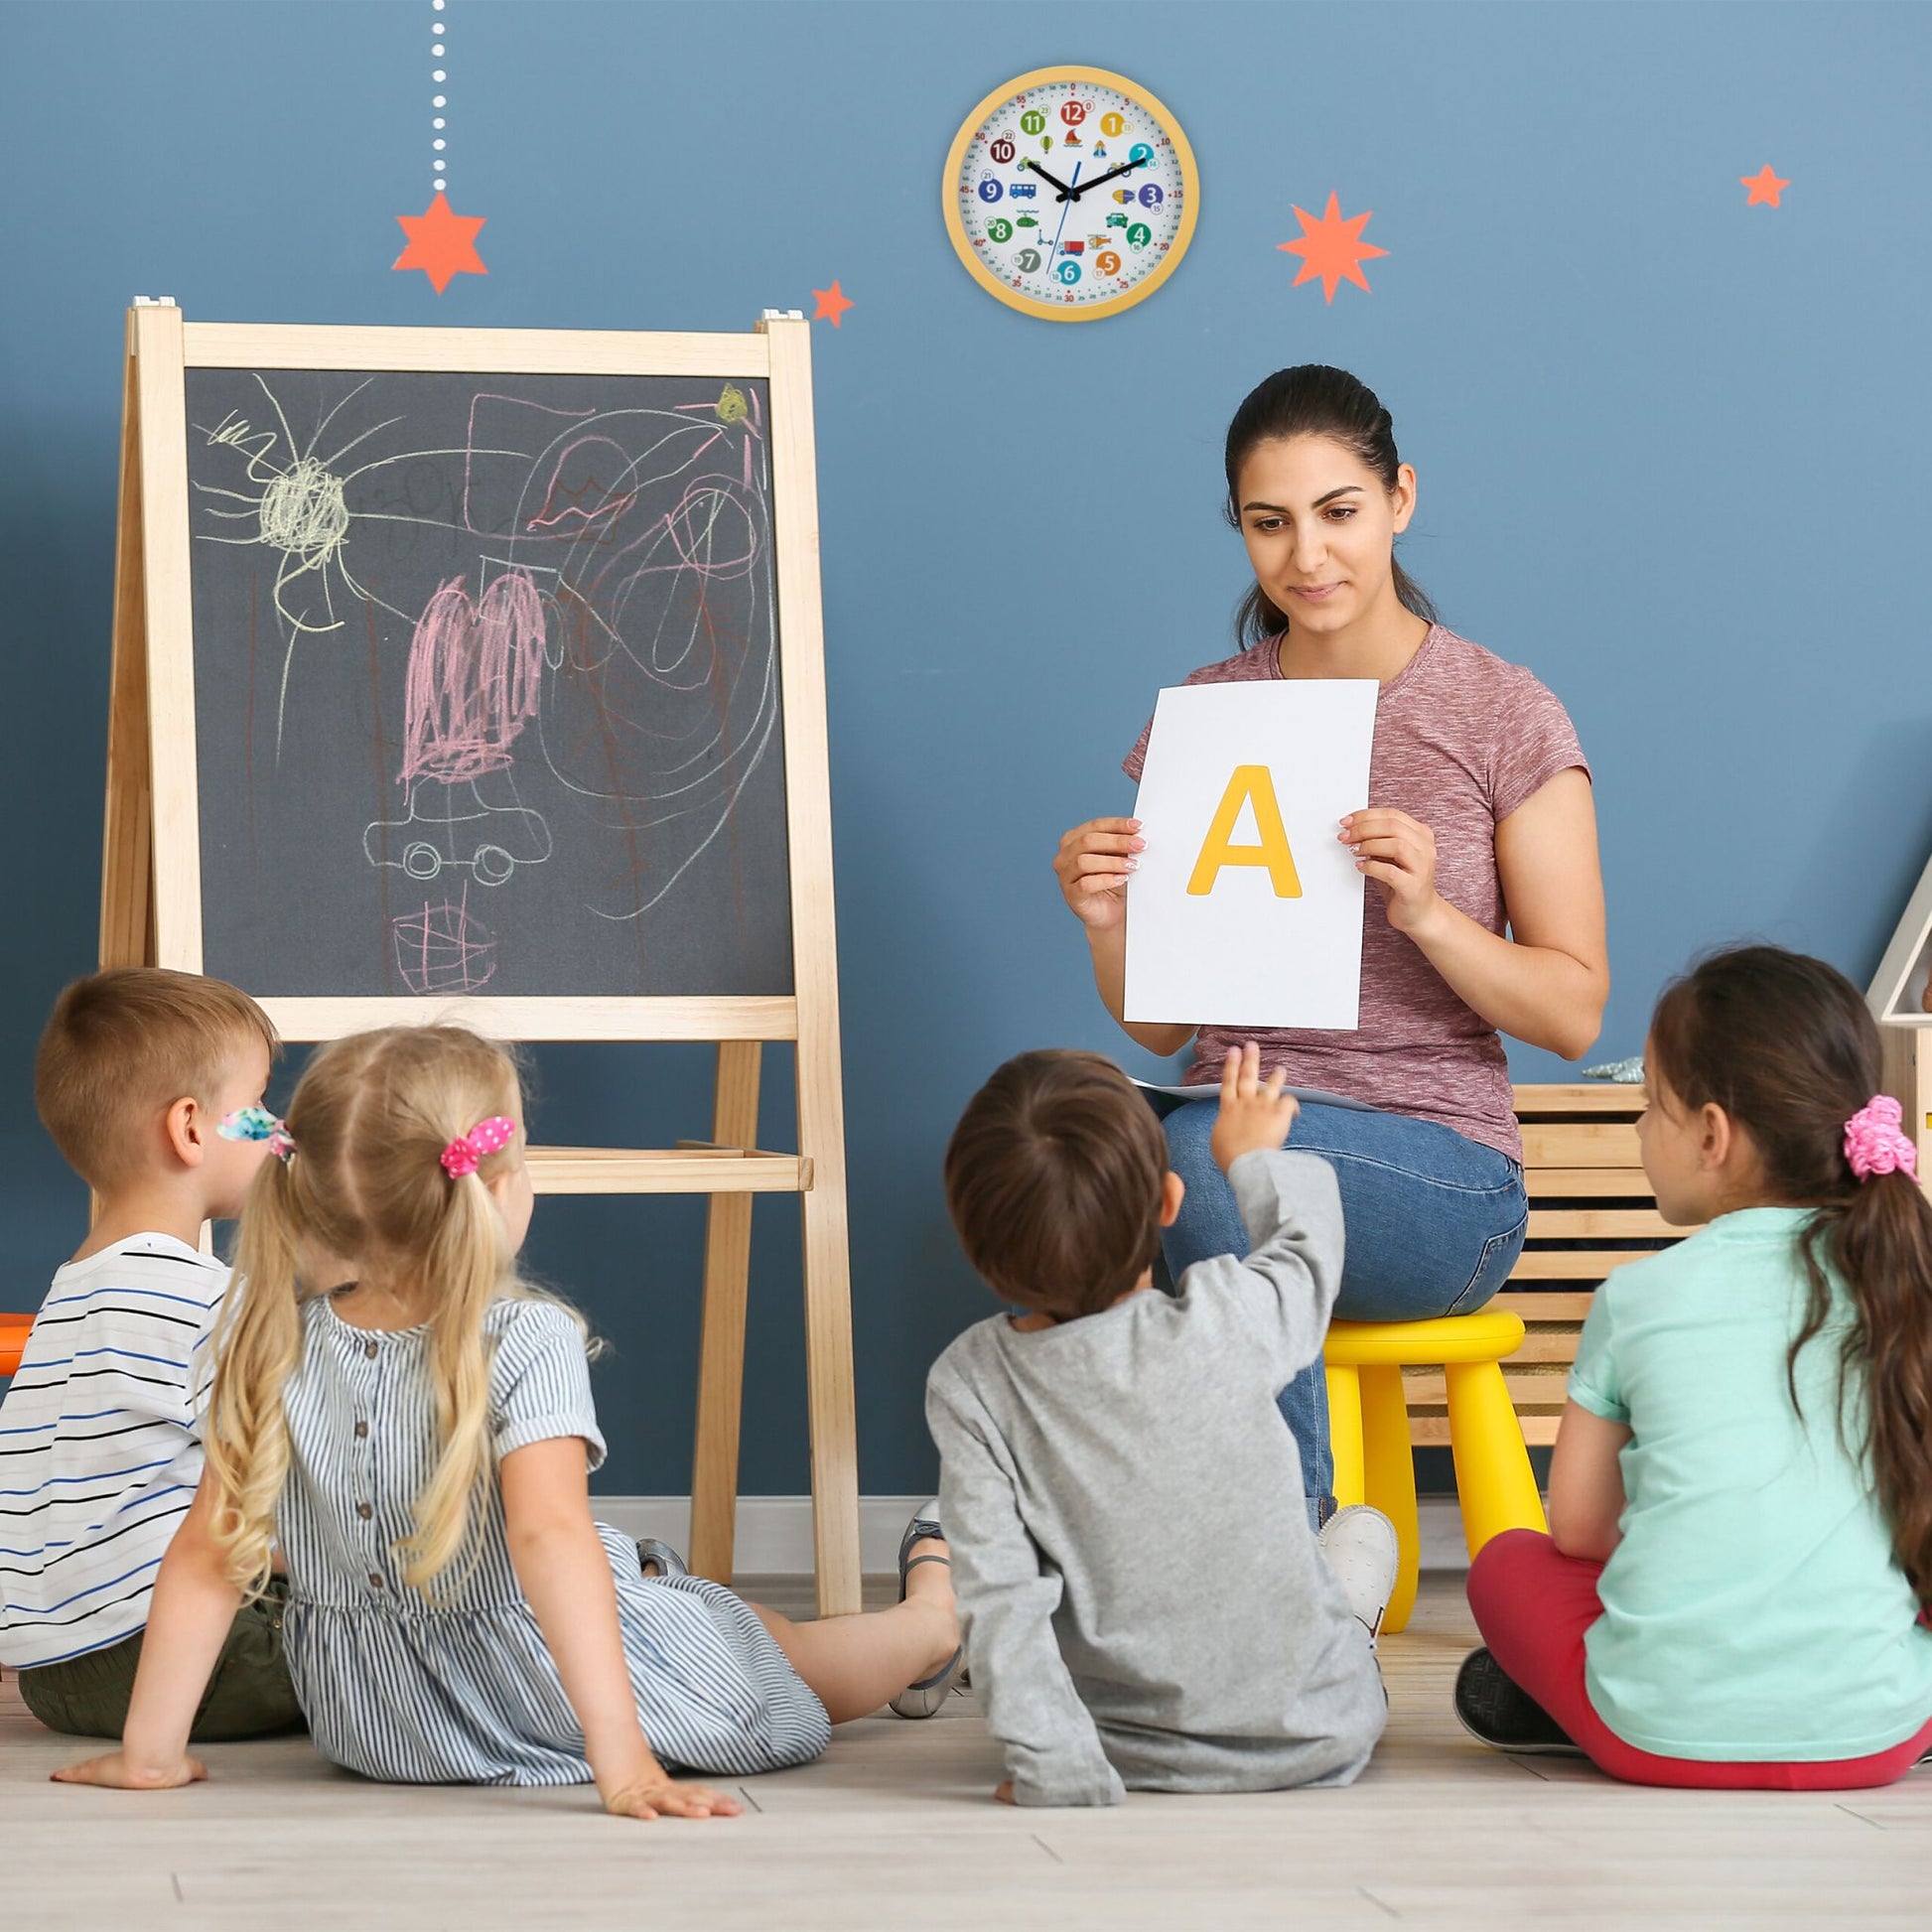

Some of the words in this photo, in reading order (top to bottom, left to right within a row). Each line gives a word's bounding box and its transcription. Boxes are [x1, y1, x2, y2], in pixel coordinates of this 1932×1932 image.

[1063, 104, 1082, 121] 12
[1025, 115, 1039, 131] 11
[1108, 117, 1116, 133] 1
[993, 144, 1012, 160] 10
[1137, 147, 1148, 161] 2
[986, 183, 997, 199] 9
[1147, 187, 1157, 204] 3
[996, 223, 1006, 238] 8
[1134, 226, 1145, 242] 4
[1025, 253, 1035, 269] 7
[1104, 255, 1114, 271] 5
[1064, 265, 1074, 280] 6
[1186, 764, 1302, 898] A
